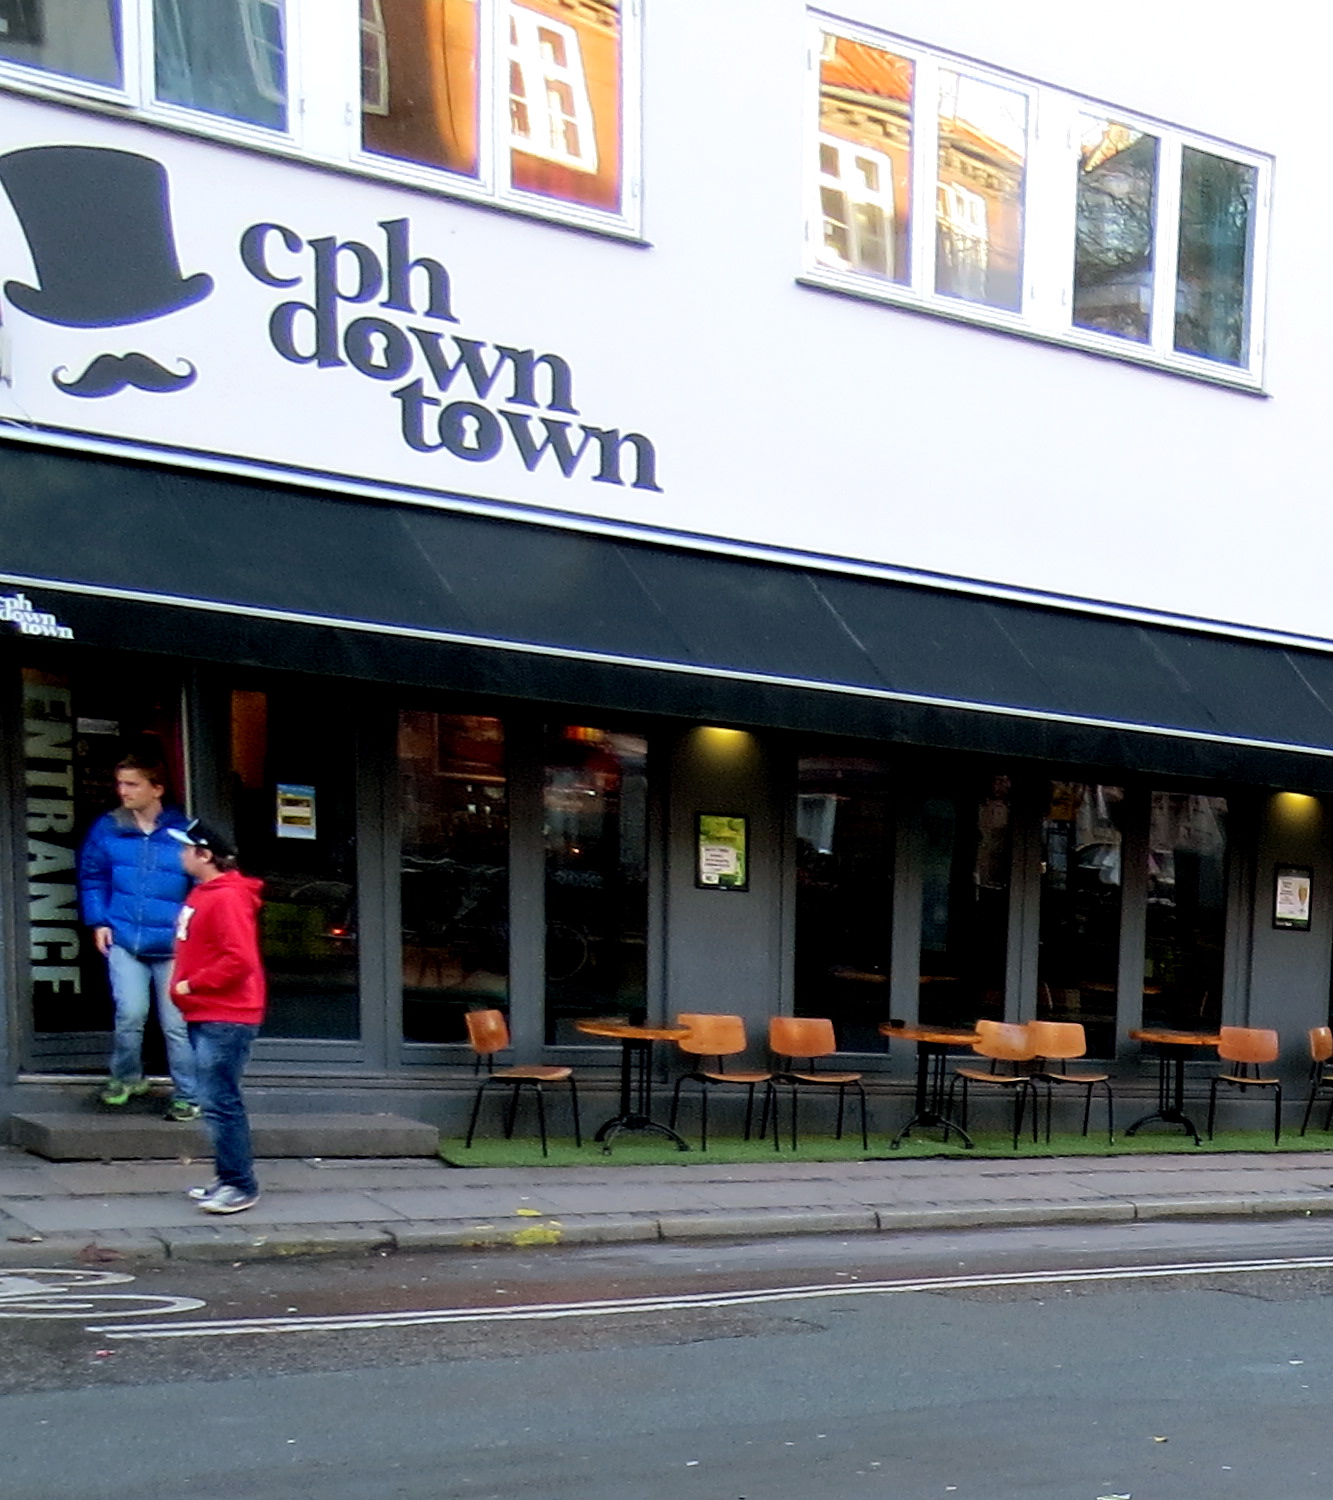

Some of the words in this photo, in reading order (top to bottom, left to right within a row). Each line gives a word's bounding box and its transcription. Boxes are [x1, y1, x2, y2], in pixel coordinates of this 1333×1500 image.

[240, 217, 460, 368] cph
[269, 237, 580, 416] down
[391, 377, 665, 494] town
[21, 680, 82, 994] ENTRANCE
